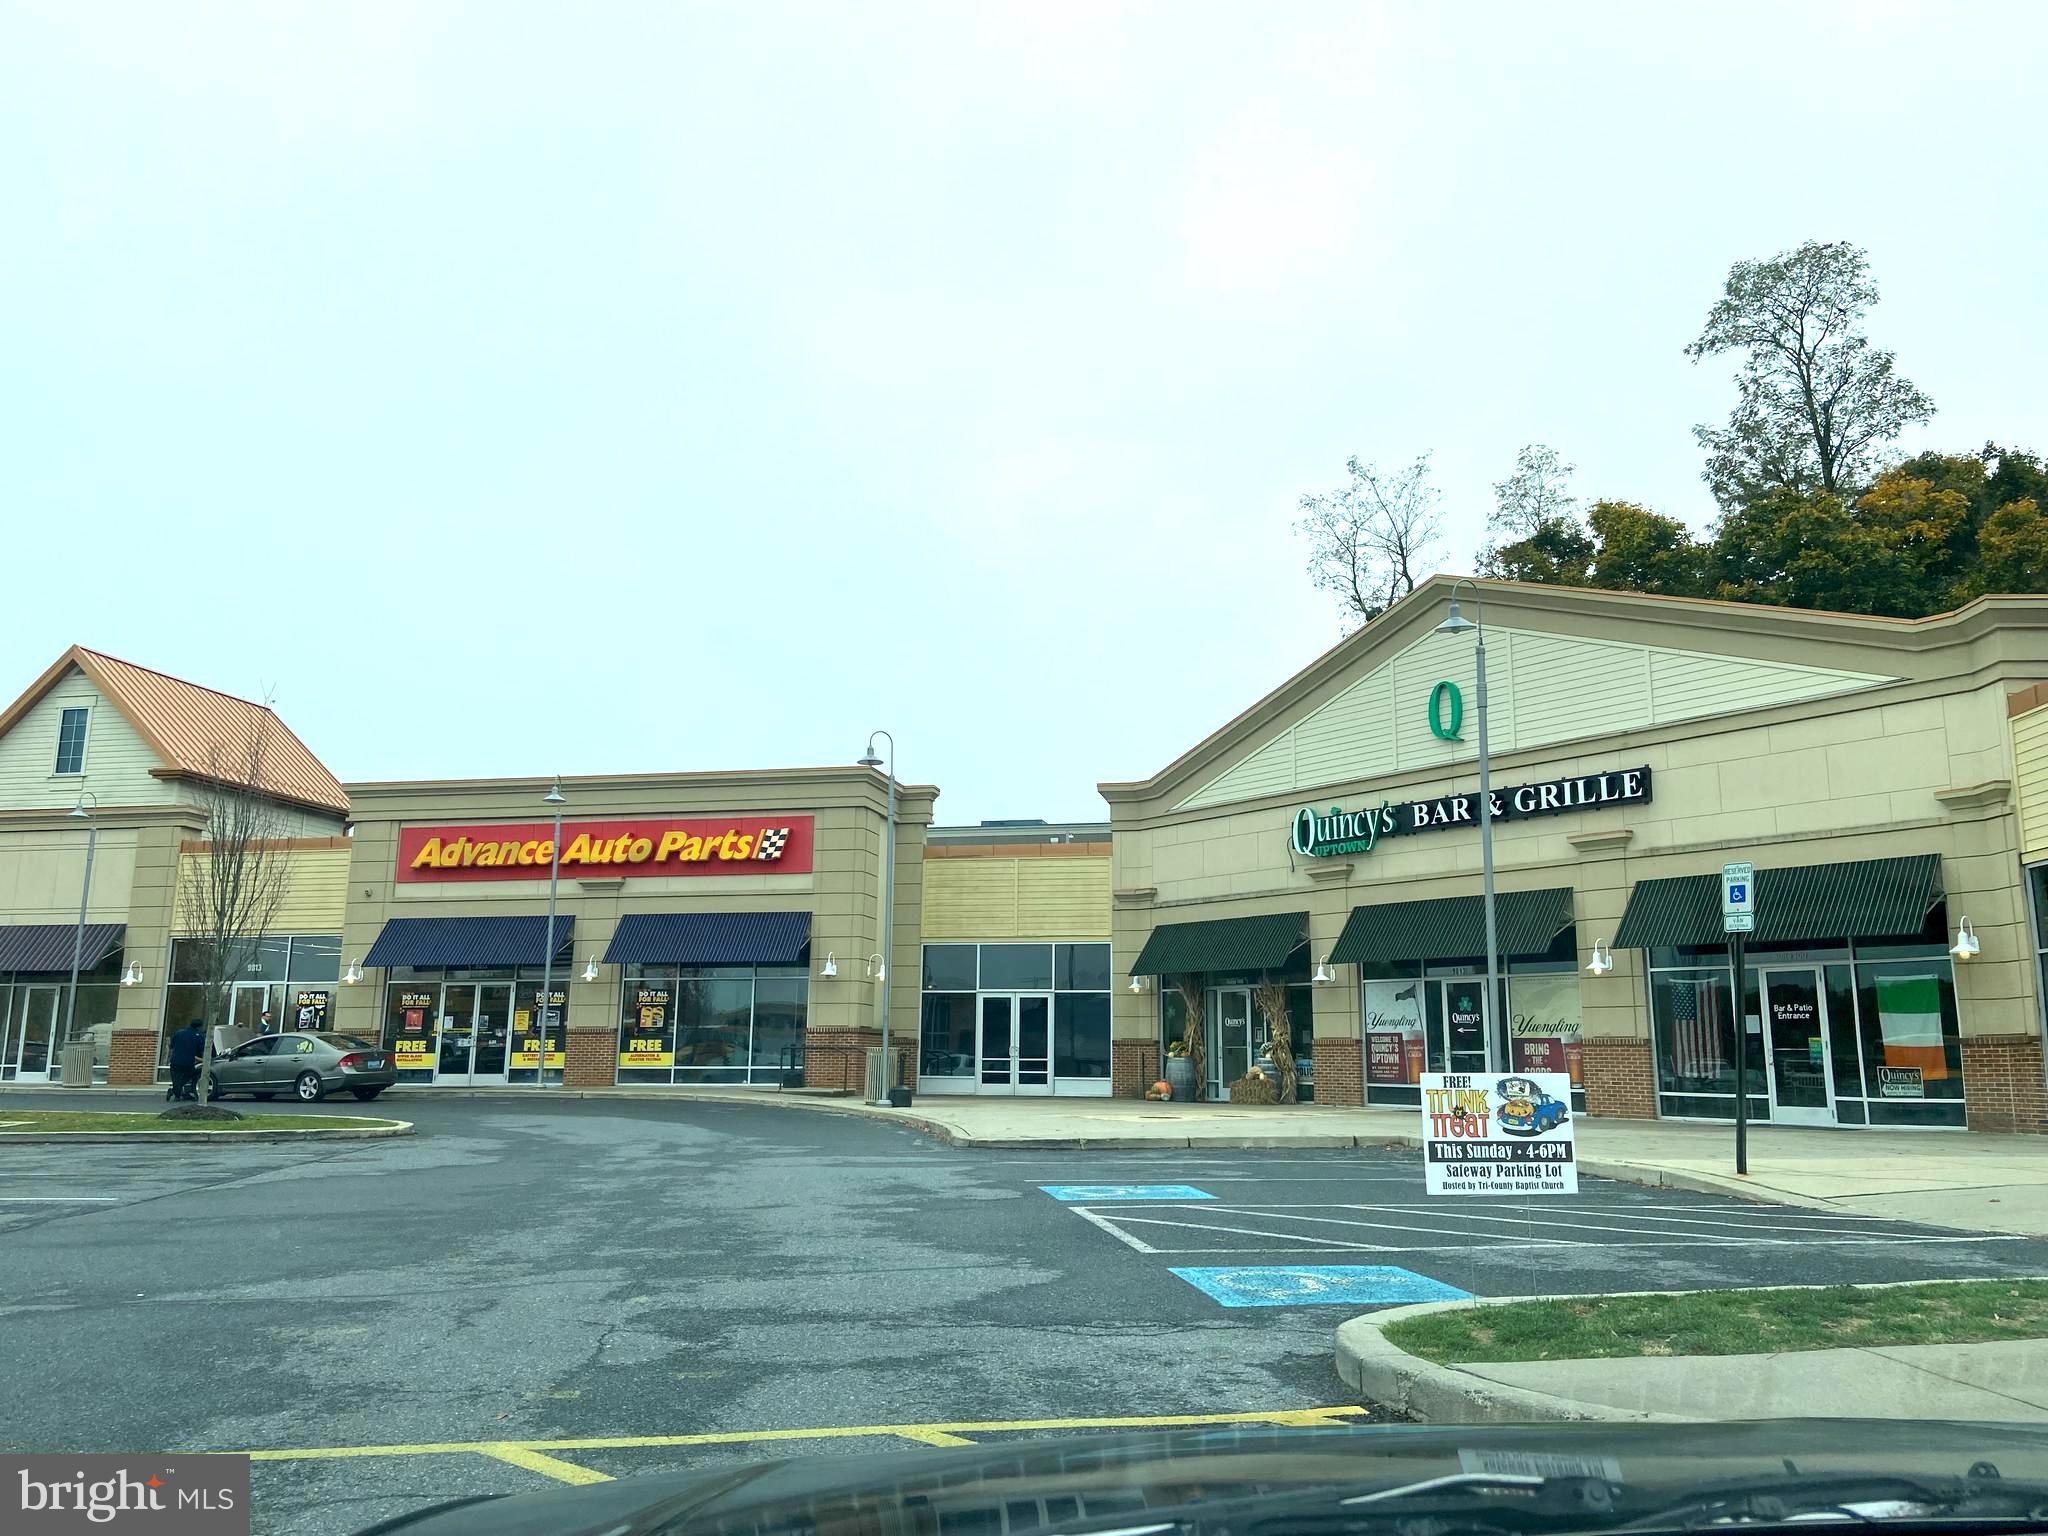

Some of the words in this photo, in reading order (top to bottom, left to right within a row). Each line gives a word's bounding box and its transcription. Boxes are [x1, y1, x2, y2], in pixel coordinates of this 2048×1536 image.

[1429, 681, 1464, 741] Q
[1292, 800, 1396, 857] Quincy's
[1412, 797, 1471, 827] BAR
[1514, 771, 1643, 812] GRILLE
[411, 836, 555, 869] Advance
[560, 832, 654, 865] Auto
[656, 827, 754, 863] Parts
[1315, 839, 1367, 857] UPTOWN
[1724, 866, 1751, 875] RESERVED
[1726, 875, 1750, 883] PARKING
[1774, 1004, 1786, 1012] Bar
[1787, 1004, 1793, 1012] &
[1794, 1003, 1813, 1012] Patio
[1367, 1011, 1417, 1030] Yuengling
[1452, 1012, 1480, 1024] Quincy's
[1778, 1011, 1810, 1020] Entrance
[1512, 1014, 1581, 1037] Yuengling
[395, 1040, 427, 1052] FREE
[629, 1039, 662, 1052] FREE
[1371, 1043, 1399, 1053] QUINCY'S
[1524, 1043, 1550, 1055] BRING
[1371, 1053, 1399, 1064] UPTOWN
[1532, 1056, 1543, 1065] THE
[1881, 1067, 1919, 1083] Quincy's
[1442, 1075, 1471, 1088] FREE!
[1435, 1143, 1462, 1159] This
[1466, 1143, 1512, 1161] Sunday
[1526, 1143, 1567, 1159] 4-6PM
[1497, 1164, 1542, 1179] Parking
[1545, 1164, 1562, 1178] Lot
[1443, 1181, 1466, 1190] Hosted
[1468, 1181, 1476, 1191] by
[1478, 1181, 1514, 1191] Tri-County
[1515, 1181, 1540, 1191] Baptist
[1541, 1181, 1565, 1190] Church
